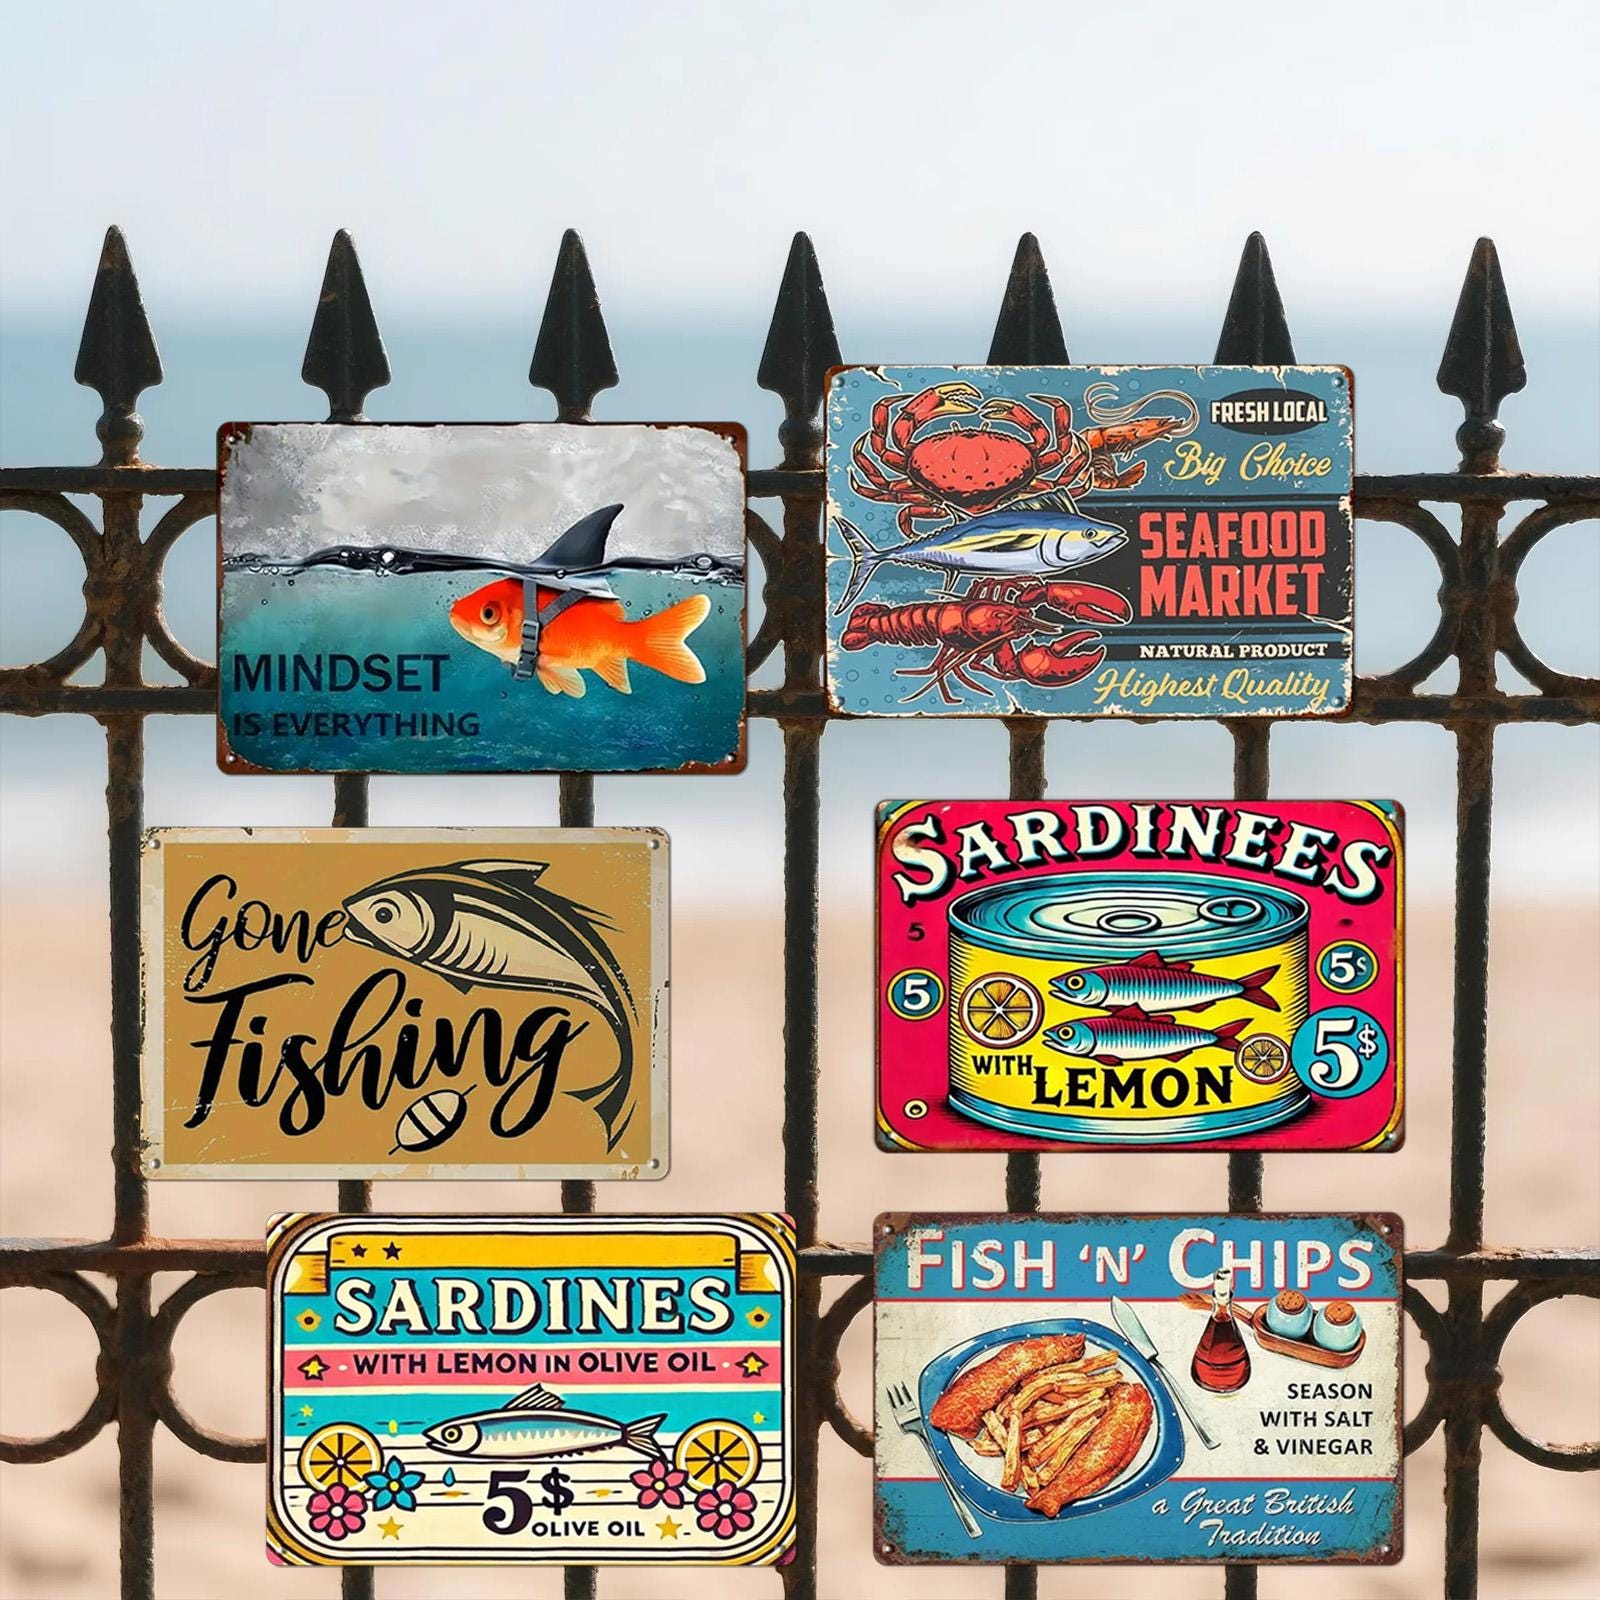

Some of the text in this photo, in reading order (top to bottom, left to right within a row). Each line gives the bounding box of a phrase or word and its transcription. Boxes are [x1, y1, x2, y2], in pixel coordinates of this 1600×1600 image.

[1211, 401, 1328, 423] FRESH LOCAL
[1164, 441, 1332, 482] Big Choice
[1139, 511, 1325, 559] SEAFOOD
[1140, 564, 1325, 617] MARKET
[1140, 643, 1328, 659] NATURAL PRODUCT
[233, 653, 450, 692] MINDSET
[1094, 669, 1331, 707] Highest Quality
[233, 712, 480, 737] IS EVERYTHING
[893, 803, 1392, 906] SARDINEES
[181, 874, 347, 992] Gone
[907, 923, 925, 941] 5
[904, 979, 930, 1011] 5
[183, 968, 589, 1138] Fishing
[1309, 1018, 1377, 1090] 5$
[971, 1055, 1236, 1110] WITH LEMON
[906, 1228, 1054, 1290] FISH
[1168, 1228, 1375, 1290] CHIPS
[334, 1277, 735, 1337] SARDINES
[353, 1352, 716, 1375] WITH LEMON IN OLIVE OIL
[1287, 1383, 1372, 1400] SEASON
[1260, 1410, 1372, 1428] WITH SALT
[1253, 1438, 1373, 1456] & VINEGAR
[482, 1467, 574, 1536] 5$
[1151, 1487, 1355, 1517] a Great British
[532, 1521, 644, 1538] OLIVE OIL
[1199, 1519, 1322, 1548] Tradition
